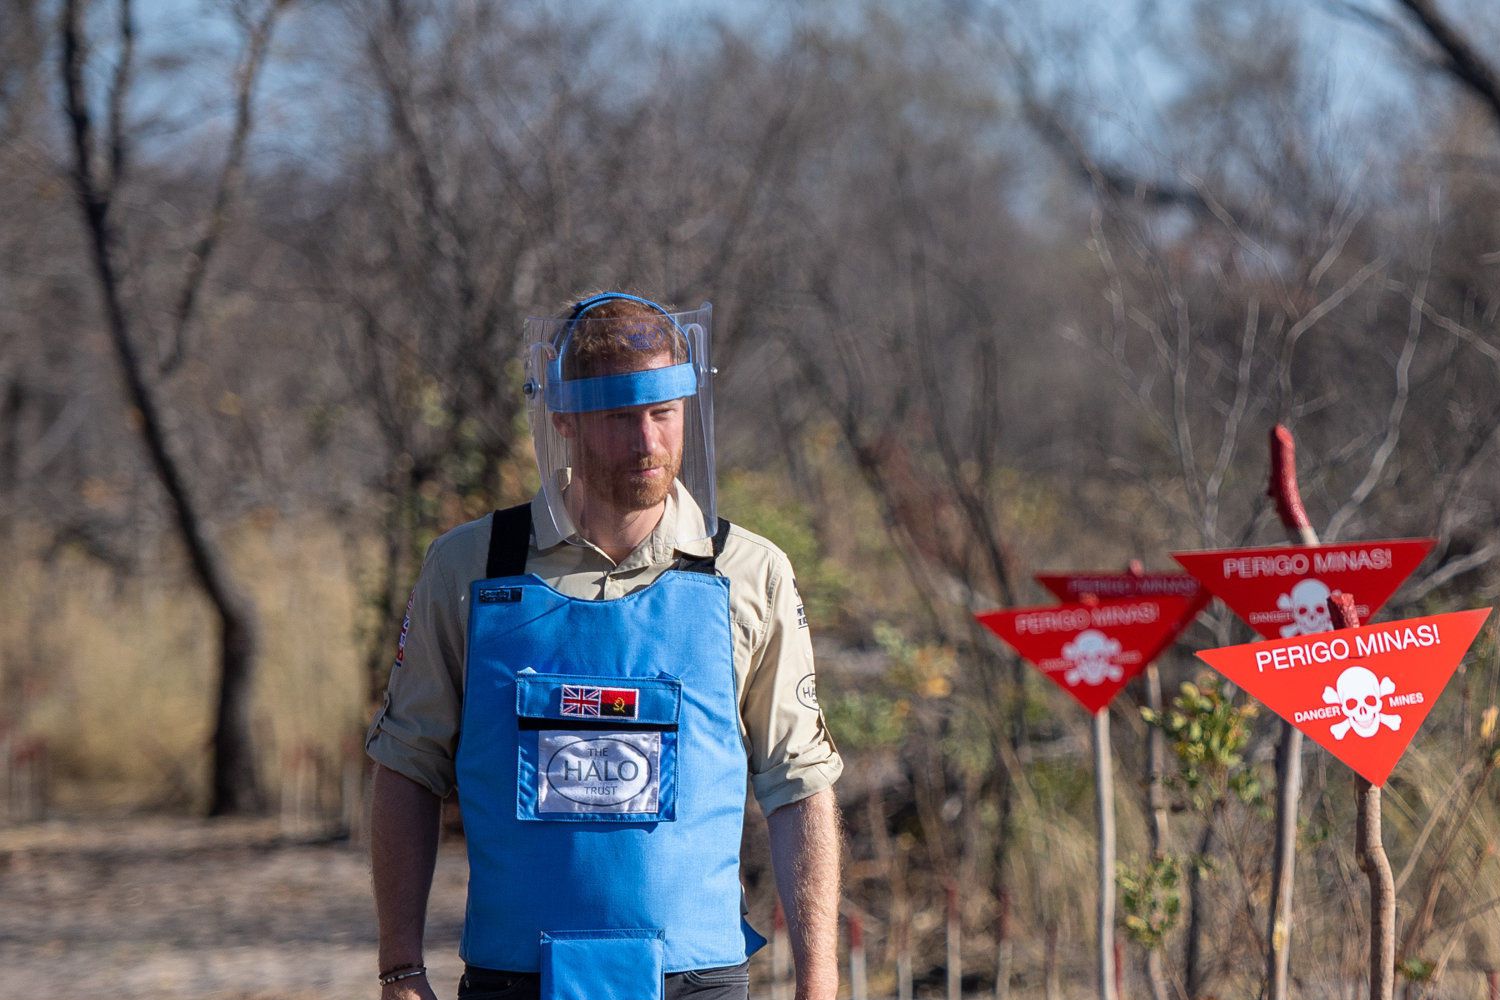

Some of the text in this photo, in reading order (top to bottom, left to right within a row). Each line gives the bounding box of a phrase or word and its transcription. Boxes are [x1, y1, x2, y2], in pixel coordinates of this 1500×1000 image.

[1223, 549, 1392, 579] PERIGO MINAS!
[1255, 624, 1441, 672] PERIGO MINAS!
[1294, 692, 1424, 723] DANGER MINES
[588, 748, 608, 757] THE
[564, 760, 638, 781] HALO
[584, 786, 618, 795] TRUST
